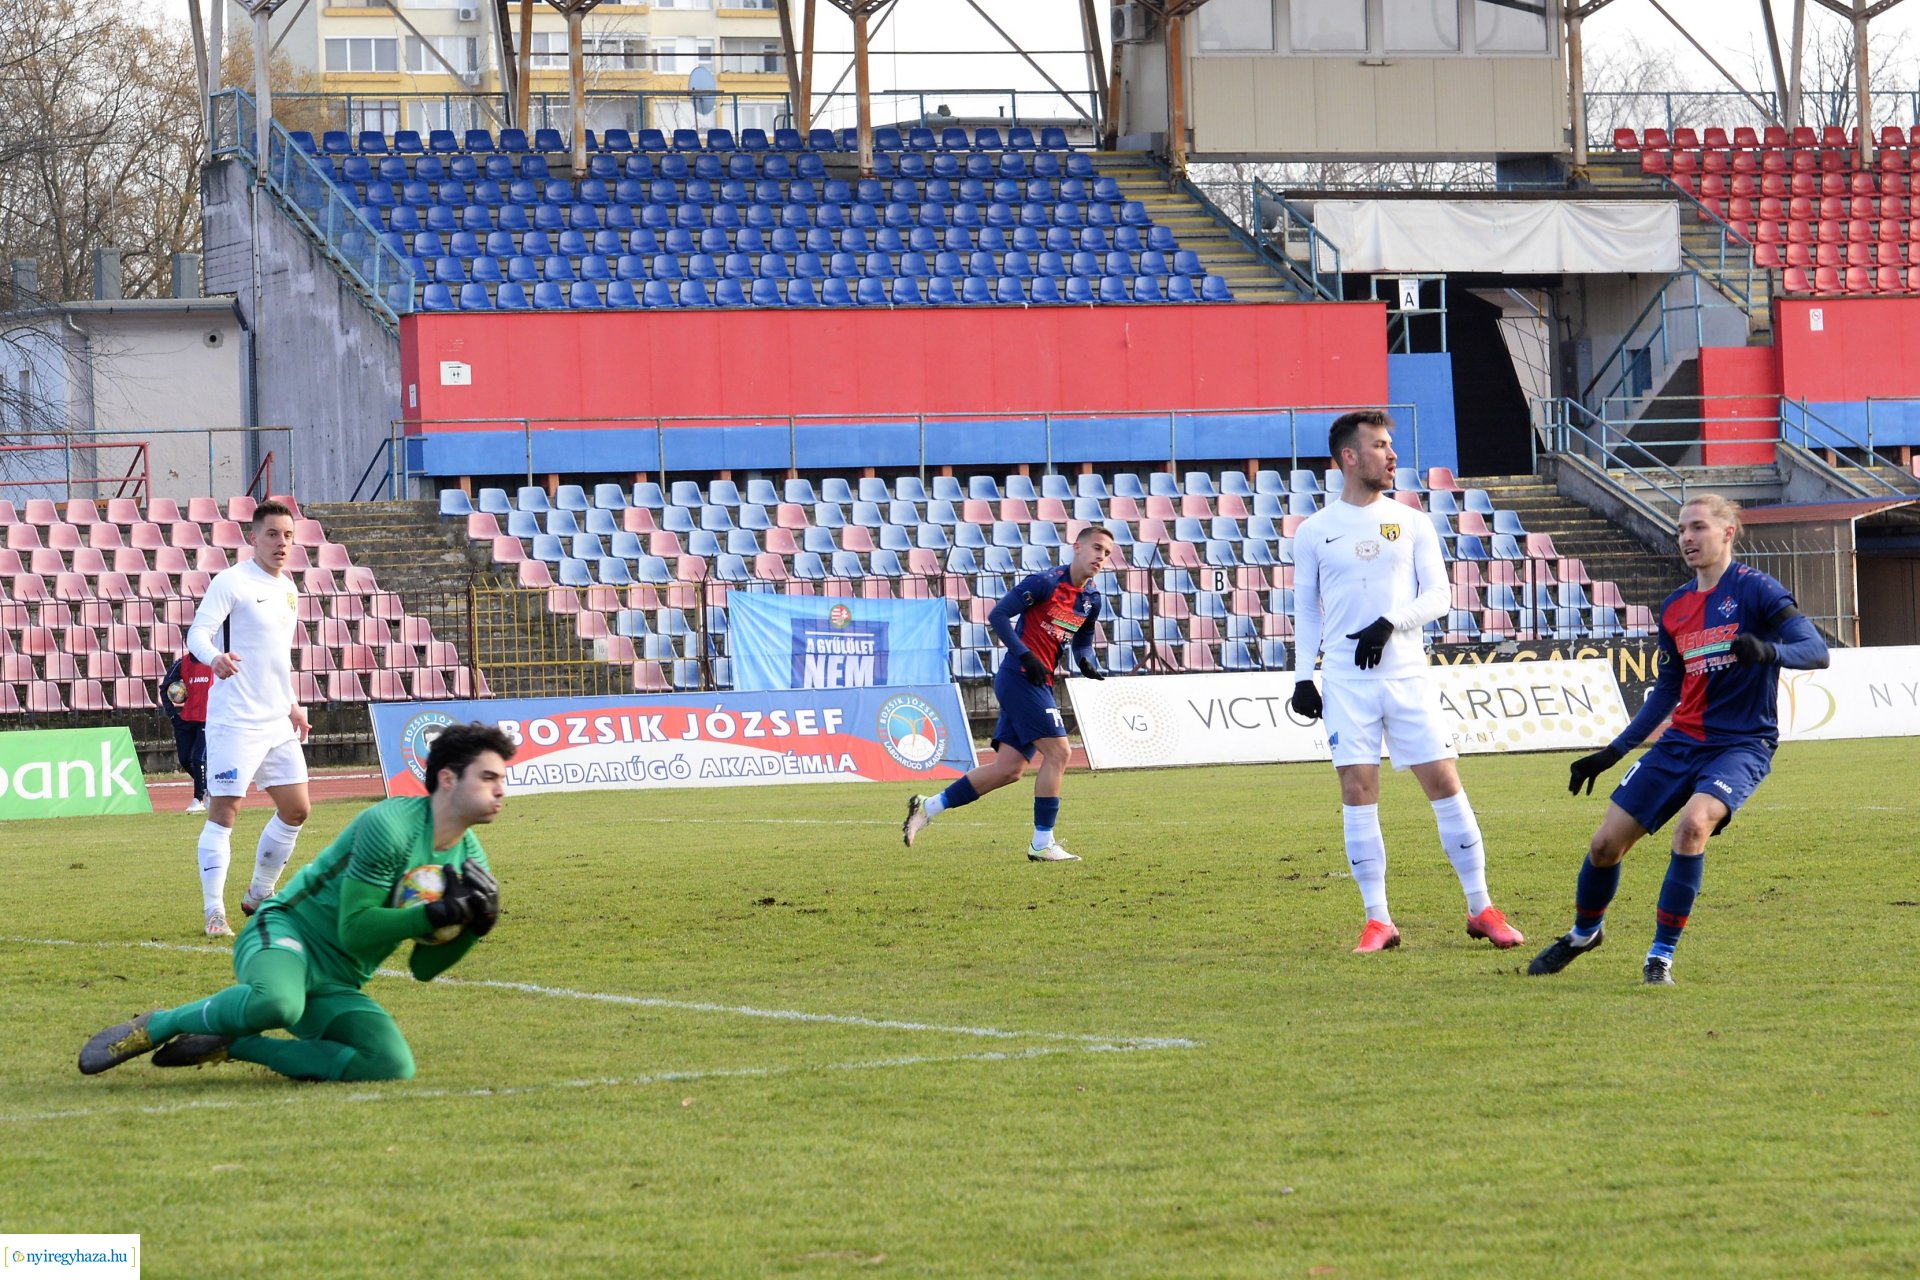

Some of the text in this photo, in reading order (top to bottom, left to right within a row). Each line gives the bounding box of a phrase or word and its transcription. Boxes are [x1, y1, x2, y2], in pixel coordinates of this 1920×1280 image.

[1404, 291, 1415, 307] A
[1214, 571, 1225, 592] B
[806, 636, 875, 655] A GYŰLÖLET
[803, 653, 875, 688] NEM
[880, 697, 904, 724] BOZSIK
[1188, 684, 1594, 730] VICTO ARDEN
[404, 714, 431, 743] BOZSIK
[497, 704, 844, 747] BOZSIK JÓZSEF
[0, 740, 138, 800] ank
[505, 749, 858, 787] LABDARÚGÓ AKADÉMIA
[1713, 779, 1733, 794] JAKO
